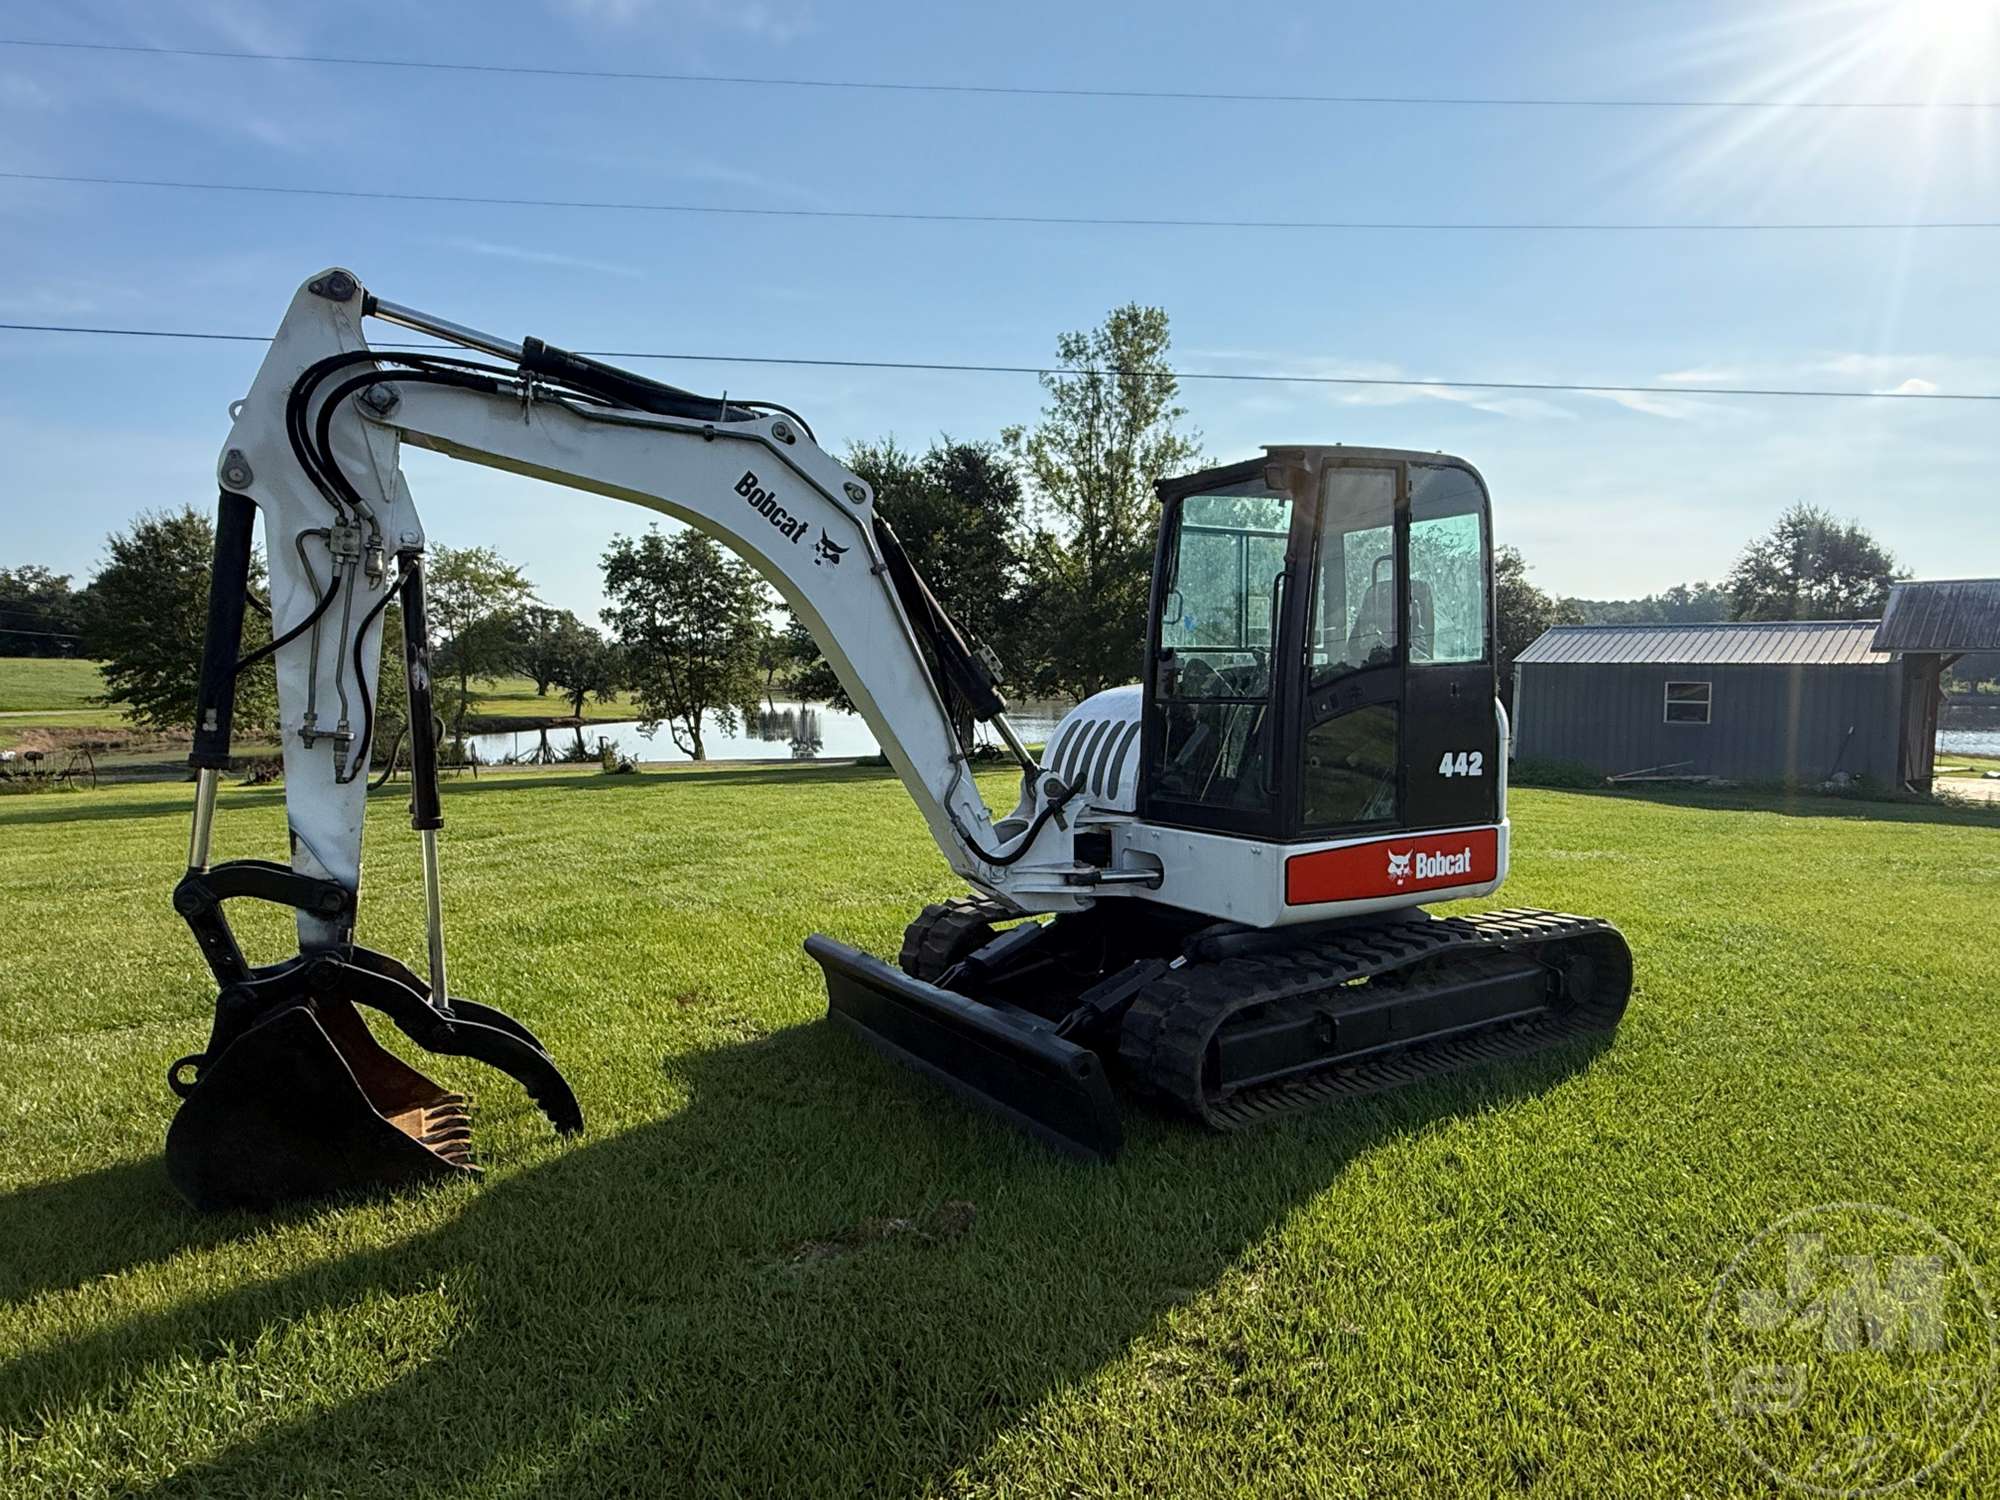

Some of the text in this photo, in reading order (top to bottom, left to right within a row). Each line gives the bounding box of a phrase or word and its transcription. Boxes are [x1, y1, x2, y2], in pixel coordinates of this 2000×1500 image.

[734, 470, 808, 544] Bobcat
[1438, 750, 1484, 778] 442
[1415, 846, 1472, 880] Bobcat
